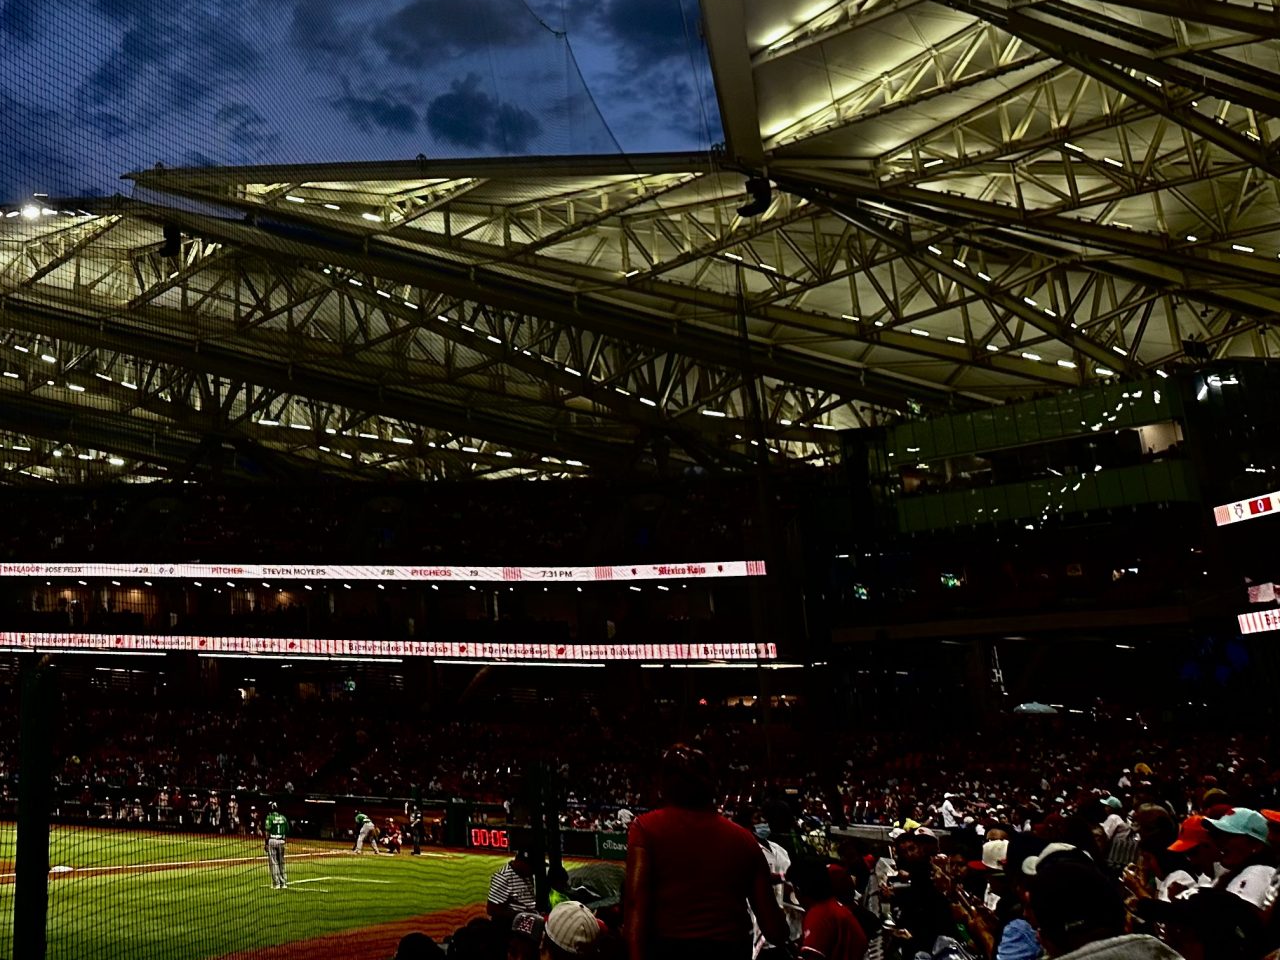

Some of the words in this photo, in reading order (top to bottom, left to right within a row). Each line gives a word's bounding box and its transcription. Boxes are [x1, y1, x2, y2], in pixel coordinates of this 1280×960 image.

[211, 566, 243, 574] PITCHER
[262, 567, 292, 576] STEVEN
[293, 567, 326, 576] MOYERS
[410, 568, 452, 577] PITCHEOS
[559, 570, 573, 578] PM
[471, 829, 508, 847] 00:06
